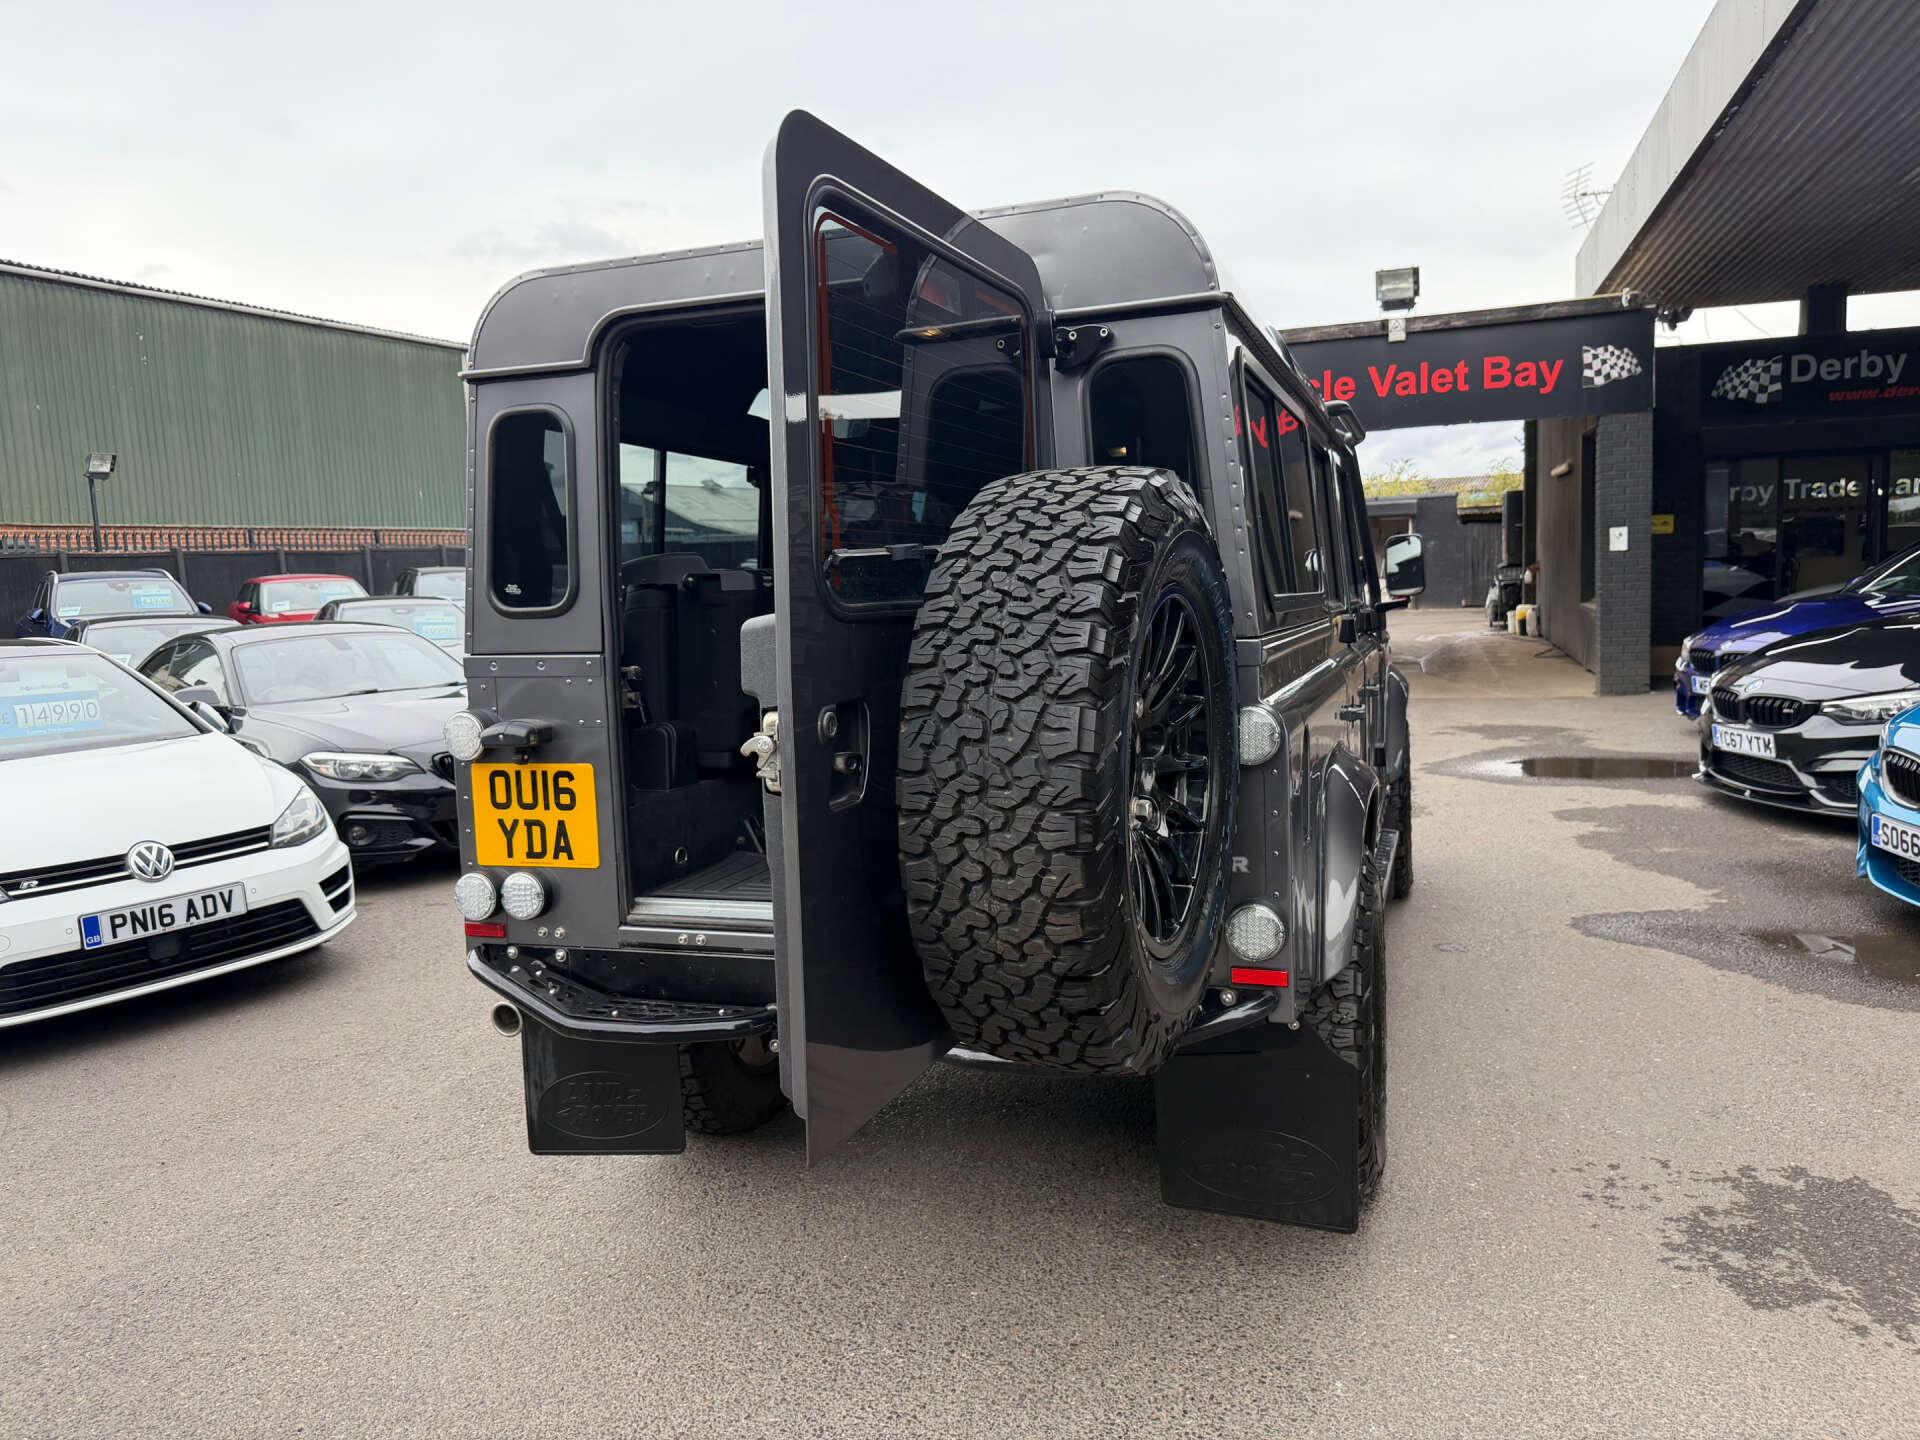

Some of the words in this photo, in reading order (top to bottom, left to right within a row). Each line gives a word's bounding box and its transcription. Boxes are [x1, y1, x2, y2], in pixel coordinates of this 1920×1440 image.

[1368, 360, 1469, 399] Valet
[1483, 355, 1565, 395] Bay
[1789, 349, 1908, 385] Derby
[1783, 476, 1863, 501] Trade
[18, 701, 98, 725] 14990
[488, 769, 577, 812] OU16
[497, 818, 575, 861] YDA
[109, 902, 176, 940] PN16
[186, 888, 234, 923] ADV
[86, 934, 101, 945] GB
